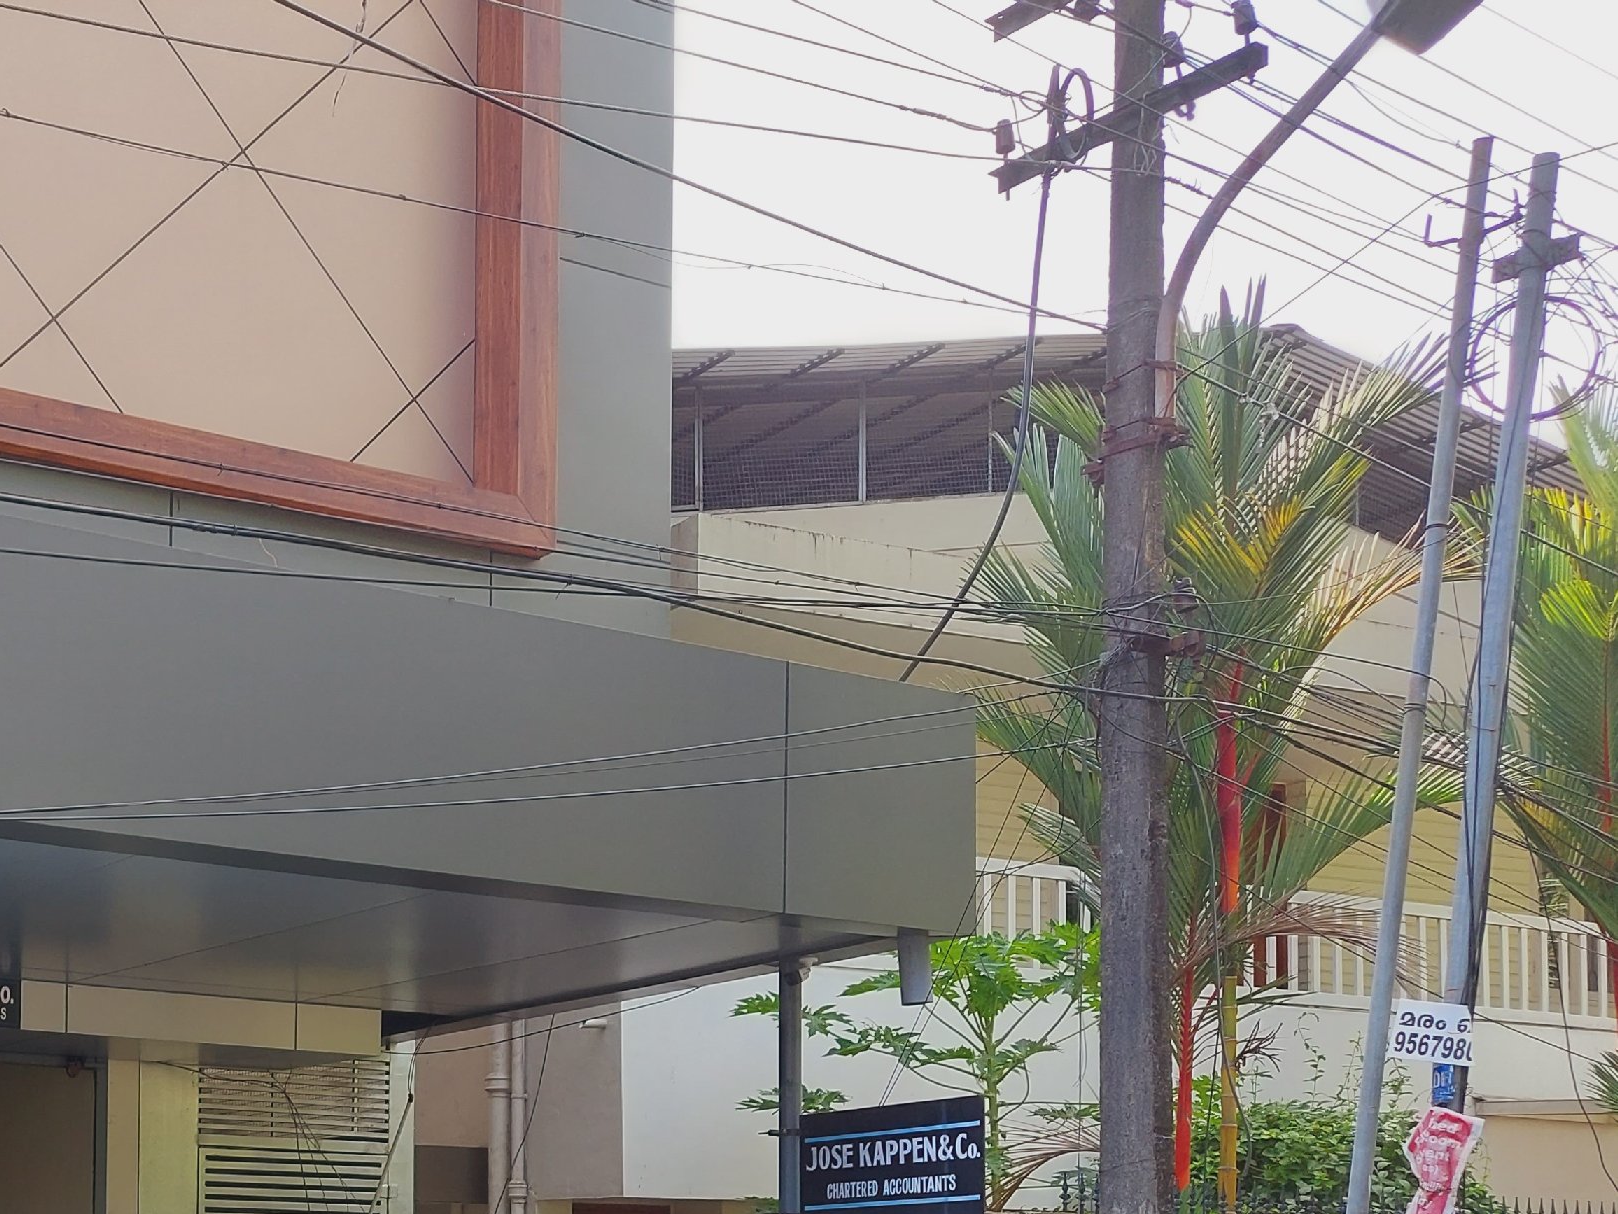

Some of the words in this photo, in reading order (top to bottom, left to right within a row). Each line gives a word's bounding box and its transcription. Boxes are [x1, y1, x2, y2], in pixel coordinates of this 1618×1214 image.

[805, 1143, 855, 1172] JOSE
[826, 1179, 879, 1200] CHARTERED
[883, 1173, 957, 1197] ACCOUNTANTS
